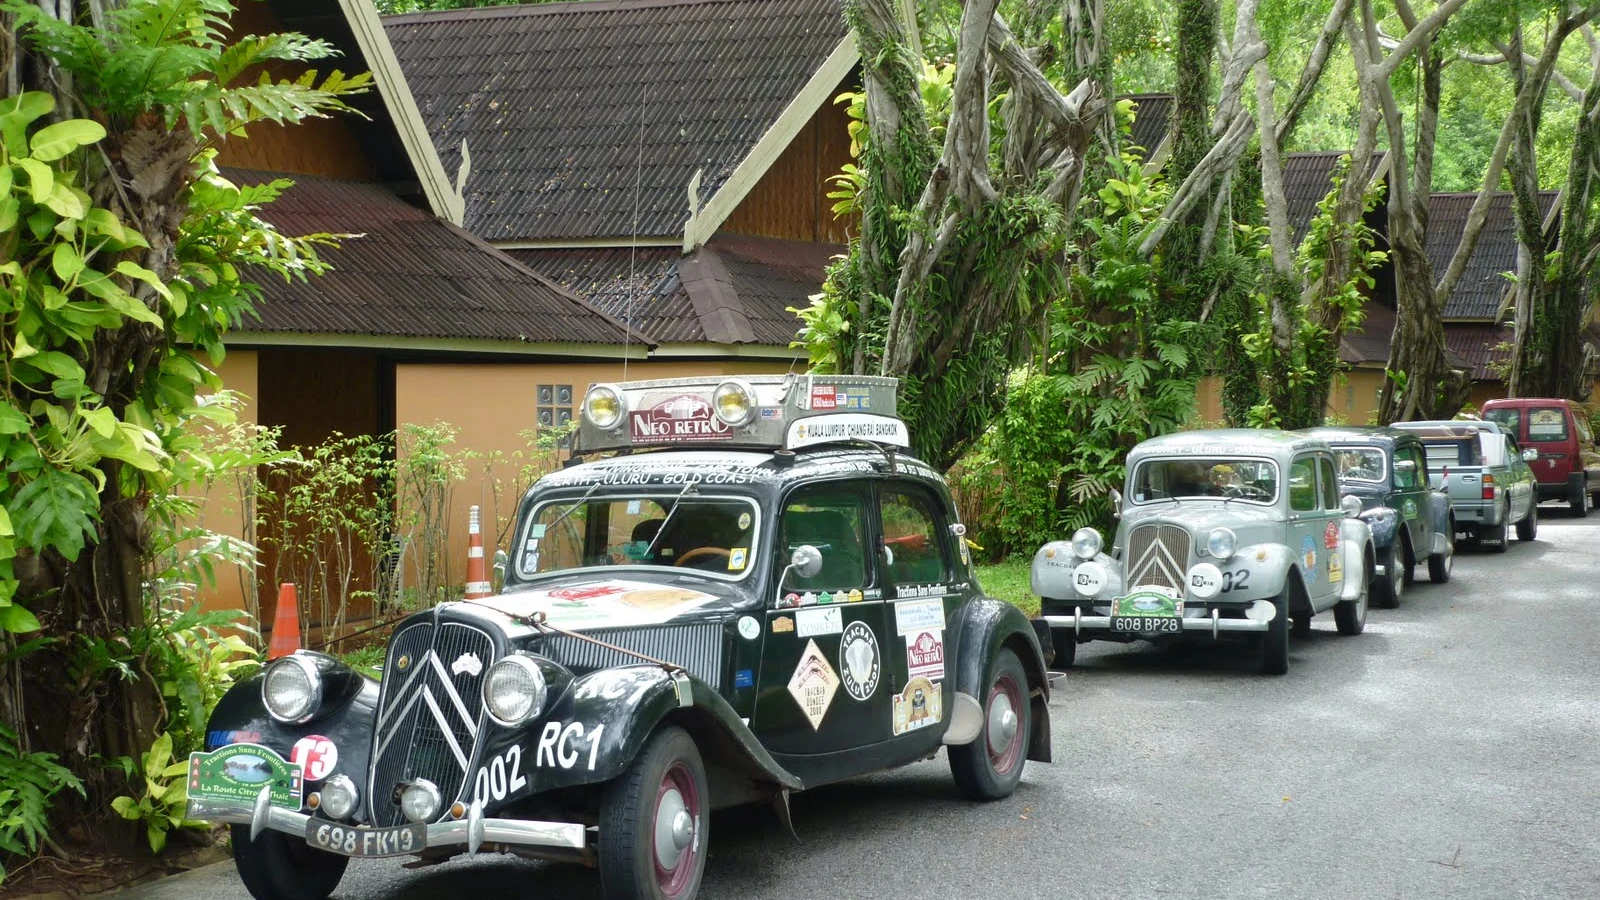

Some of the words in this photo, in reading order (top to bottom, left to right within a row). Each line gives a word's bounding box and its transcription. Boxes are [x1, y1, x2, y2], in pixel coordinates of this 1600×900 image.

[634, 413, 671, 436] NEO
[675, 413, 729, 434] RETRO
[807, 424, 824, 438] KUALA
[824, 424, 845, 437] LUMPUR
[847, 423, 867, 437] CHIANG
[875, 423, 898, 437] BANGKOK
[603, 472, 652, 485] ULURU
[662, 472, 702, 484] GOLD
[705, 472, 758, 484] COAST
[735, 465, 776, 475] TOWN
[896, 585, 917, 598] Tractions
[917, 584, 928, 597] Sans
[1116, 617, 1141, 631] 608
[1144, 617, 1178, 632] BP28
[843, 626, 874, 649] TRACBAR
[909, 649, 924, 666] NEO
[924, 645, 942, 663] RETRO
[843, 667, 860, 695] ZULU
[865, 664, 878, 693] 2004
[804, 686, 825, 697] TRACBAR
[806, 695, 825, 707] DUNDEE
[809, 706, 822, 716] 2000
[203, 748, 237, 767] Tractions
[238, 746, 256, 755] Sans
[536, 721, 605, 771] RC1
[292, 737, 338, 779] T3
[474, 744, 527, 810] 002
[201, 783, 212, 792] La
[213, 784, 237, 794] Route
[238, 787, 261, 797] Citro
[316, 824, 357, 853] 698
[363, 828, 413, 855] FK19
